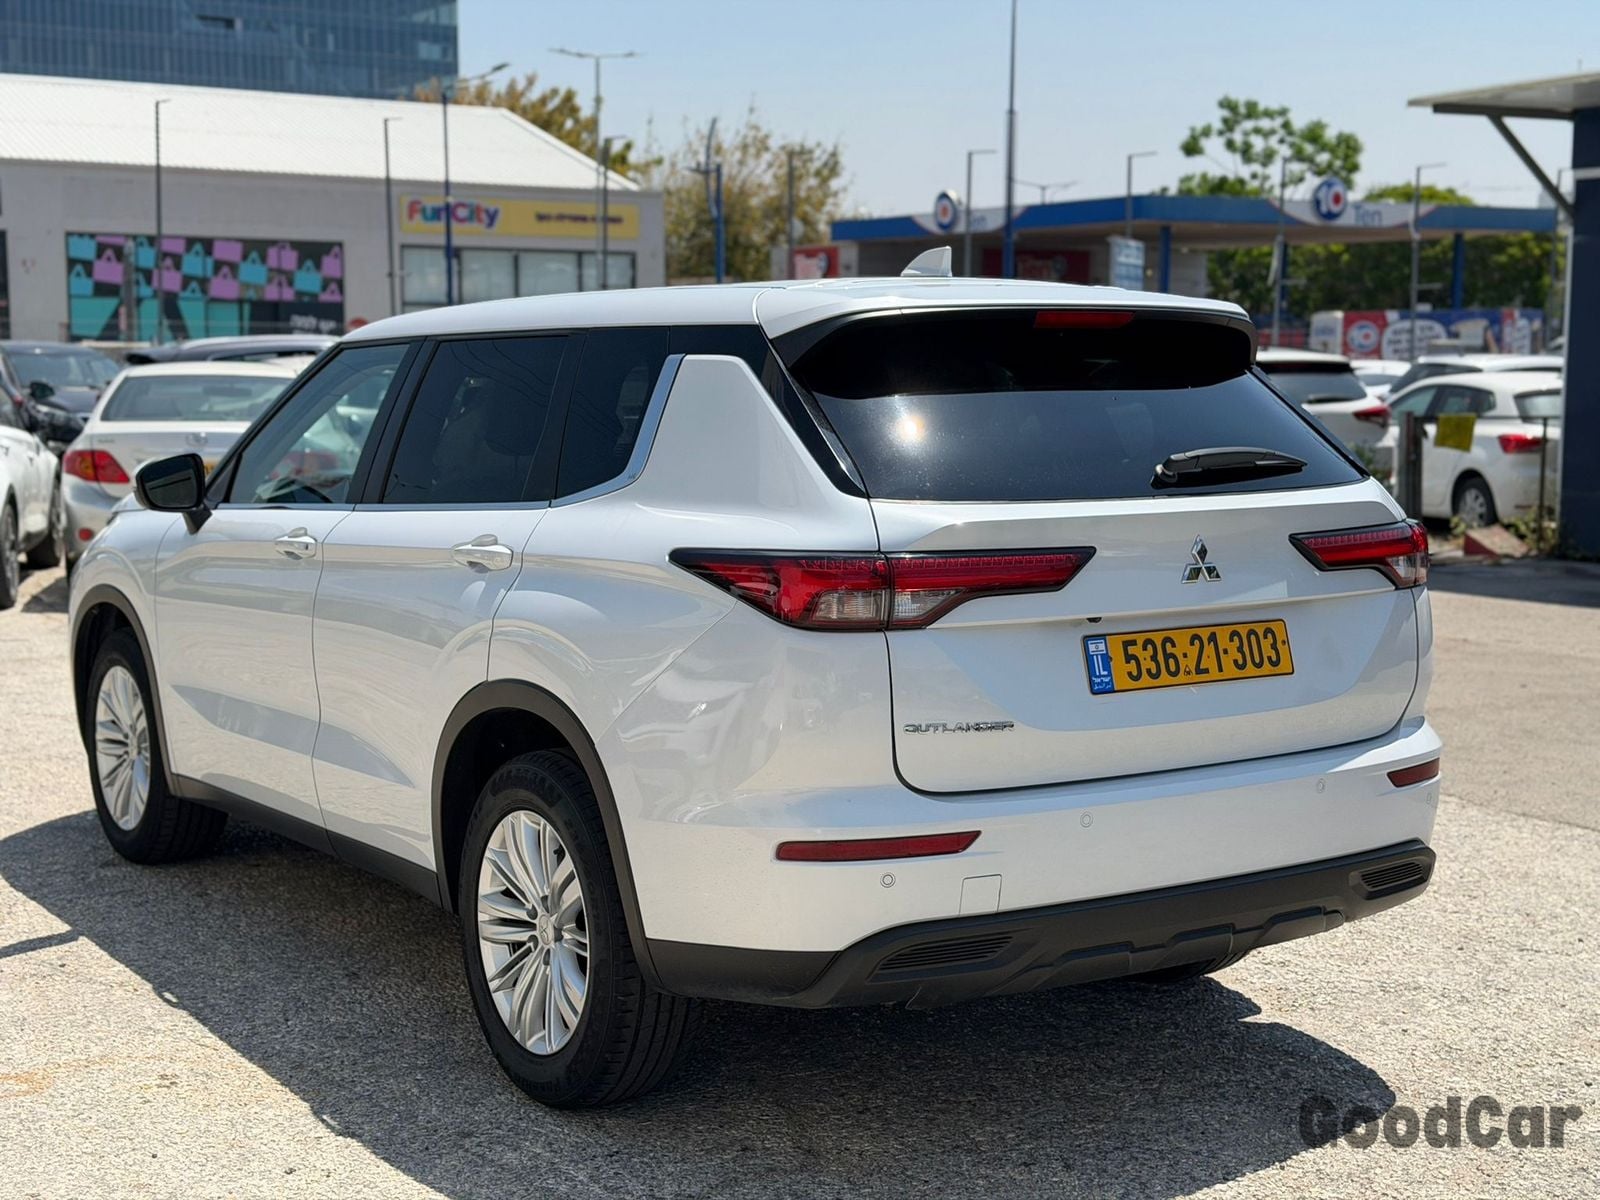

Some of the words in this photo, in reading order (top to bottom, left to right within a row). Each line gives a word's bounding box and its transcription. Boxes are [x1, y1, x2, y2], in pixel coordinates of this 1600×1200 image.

[407, 200, 499, 229] FunCity
[1353, 203, 1383, 226] Ten
[1093, 655, 1109, 676] IL
[1121, 627, 1281, 682] 536-21-303
[903, 721, 1014, 733] OUTLANDER
